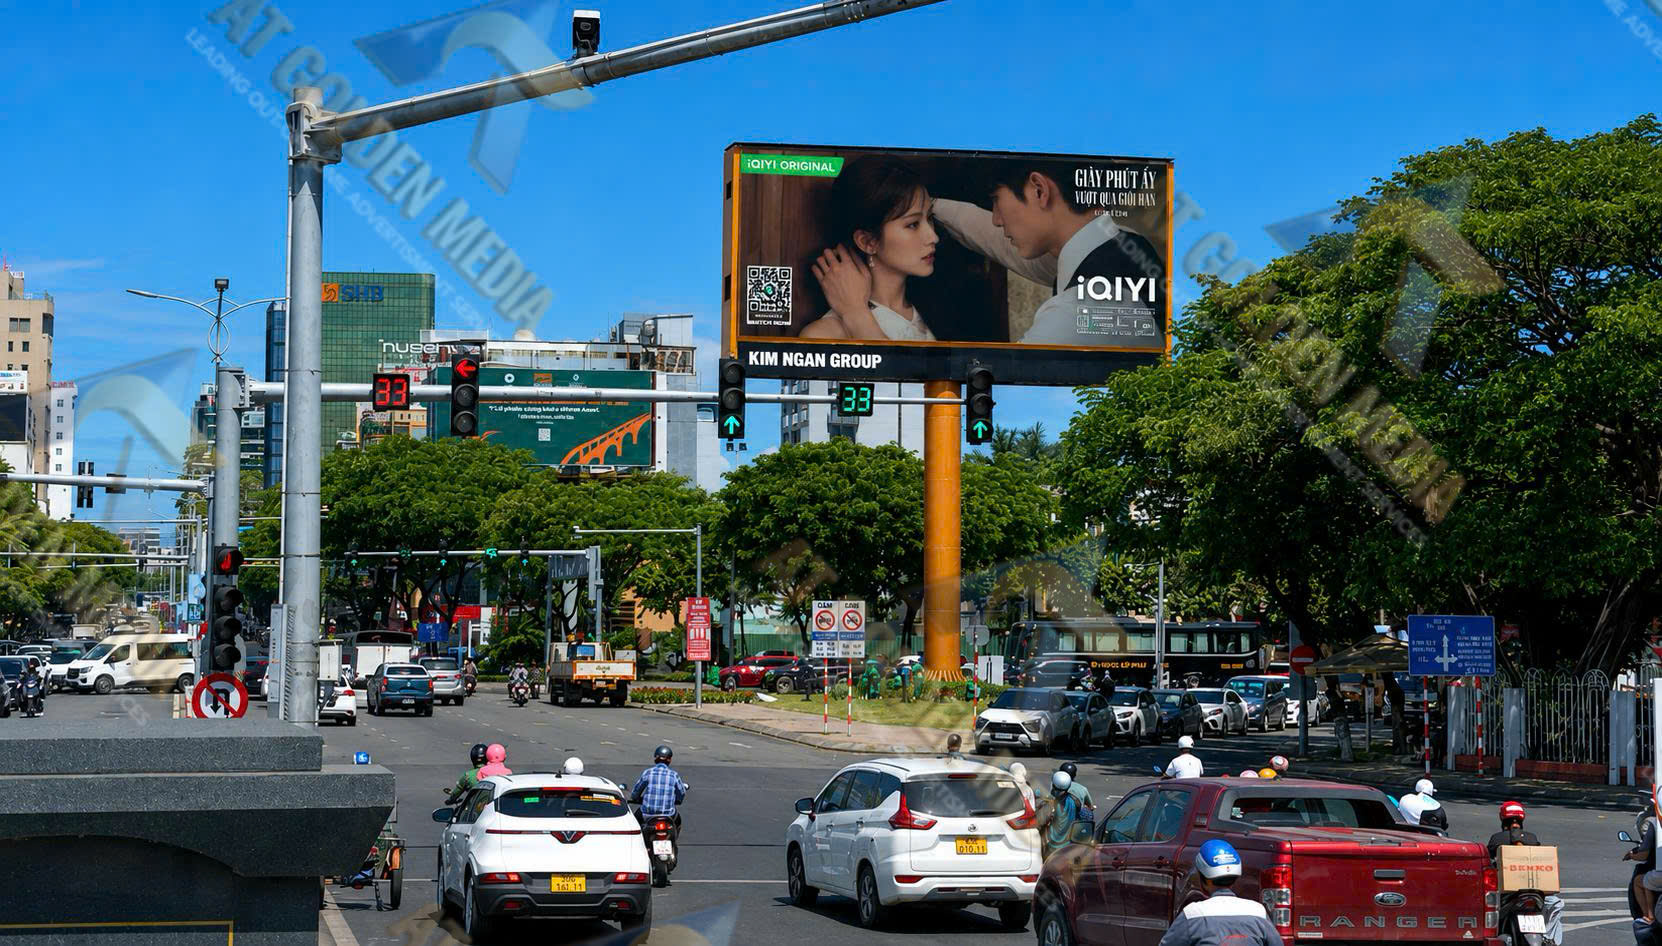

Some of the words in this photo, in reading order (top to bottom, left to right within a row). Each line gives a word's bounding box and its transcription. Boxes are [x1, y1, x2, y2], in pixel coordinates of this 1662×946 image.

[747, 159, 776, 169] iQIYI
[780, 160, 835, 172] ORIGINAL
[1106, 167, 1138, 189] PHÚT
[1141, 166, 1157, 189] ẤY
[1100, 191, 1116, 207] QUA
[1077, 275, 1156, 302] iQIYI
[748, 351, 778, 366] KIM
[782, 352, 826, 367] NGAN
[830, 353, 882, 369] GROUP
[376, 378, 407, 405] 33
[843, 387, 871, 411] 33
[1300, 915, 1478, 928] RANGER
